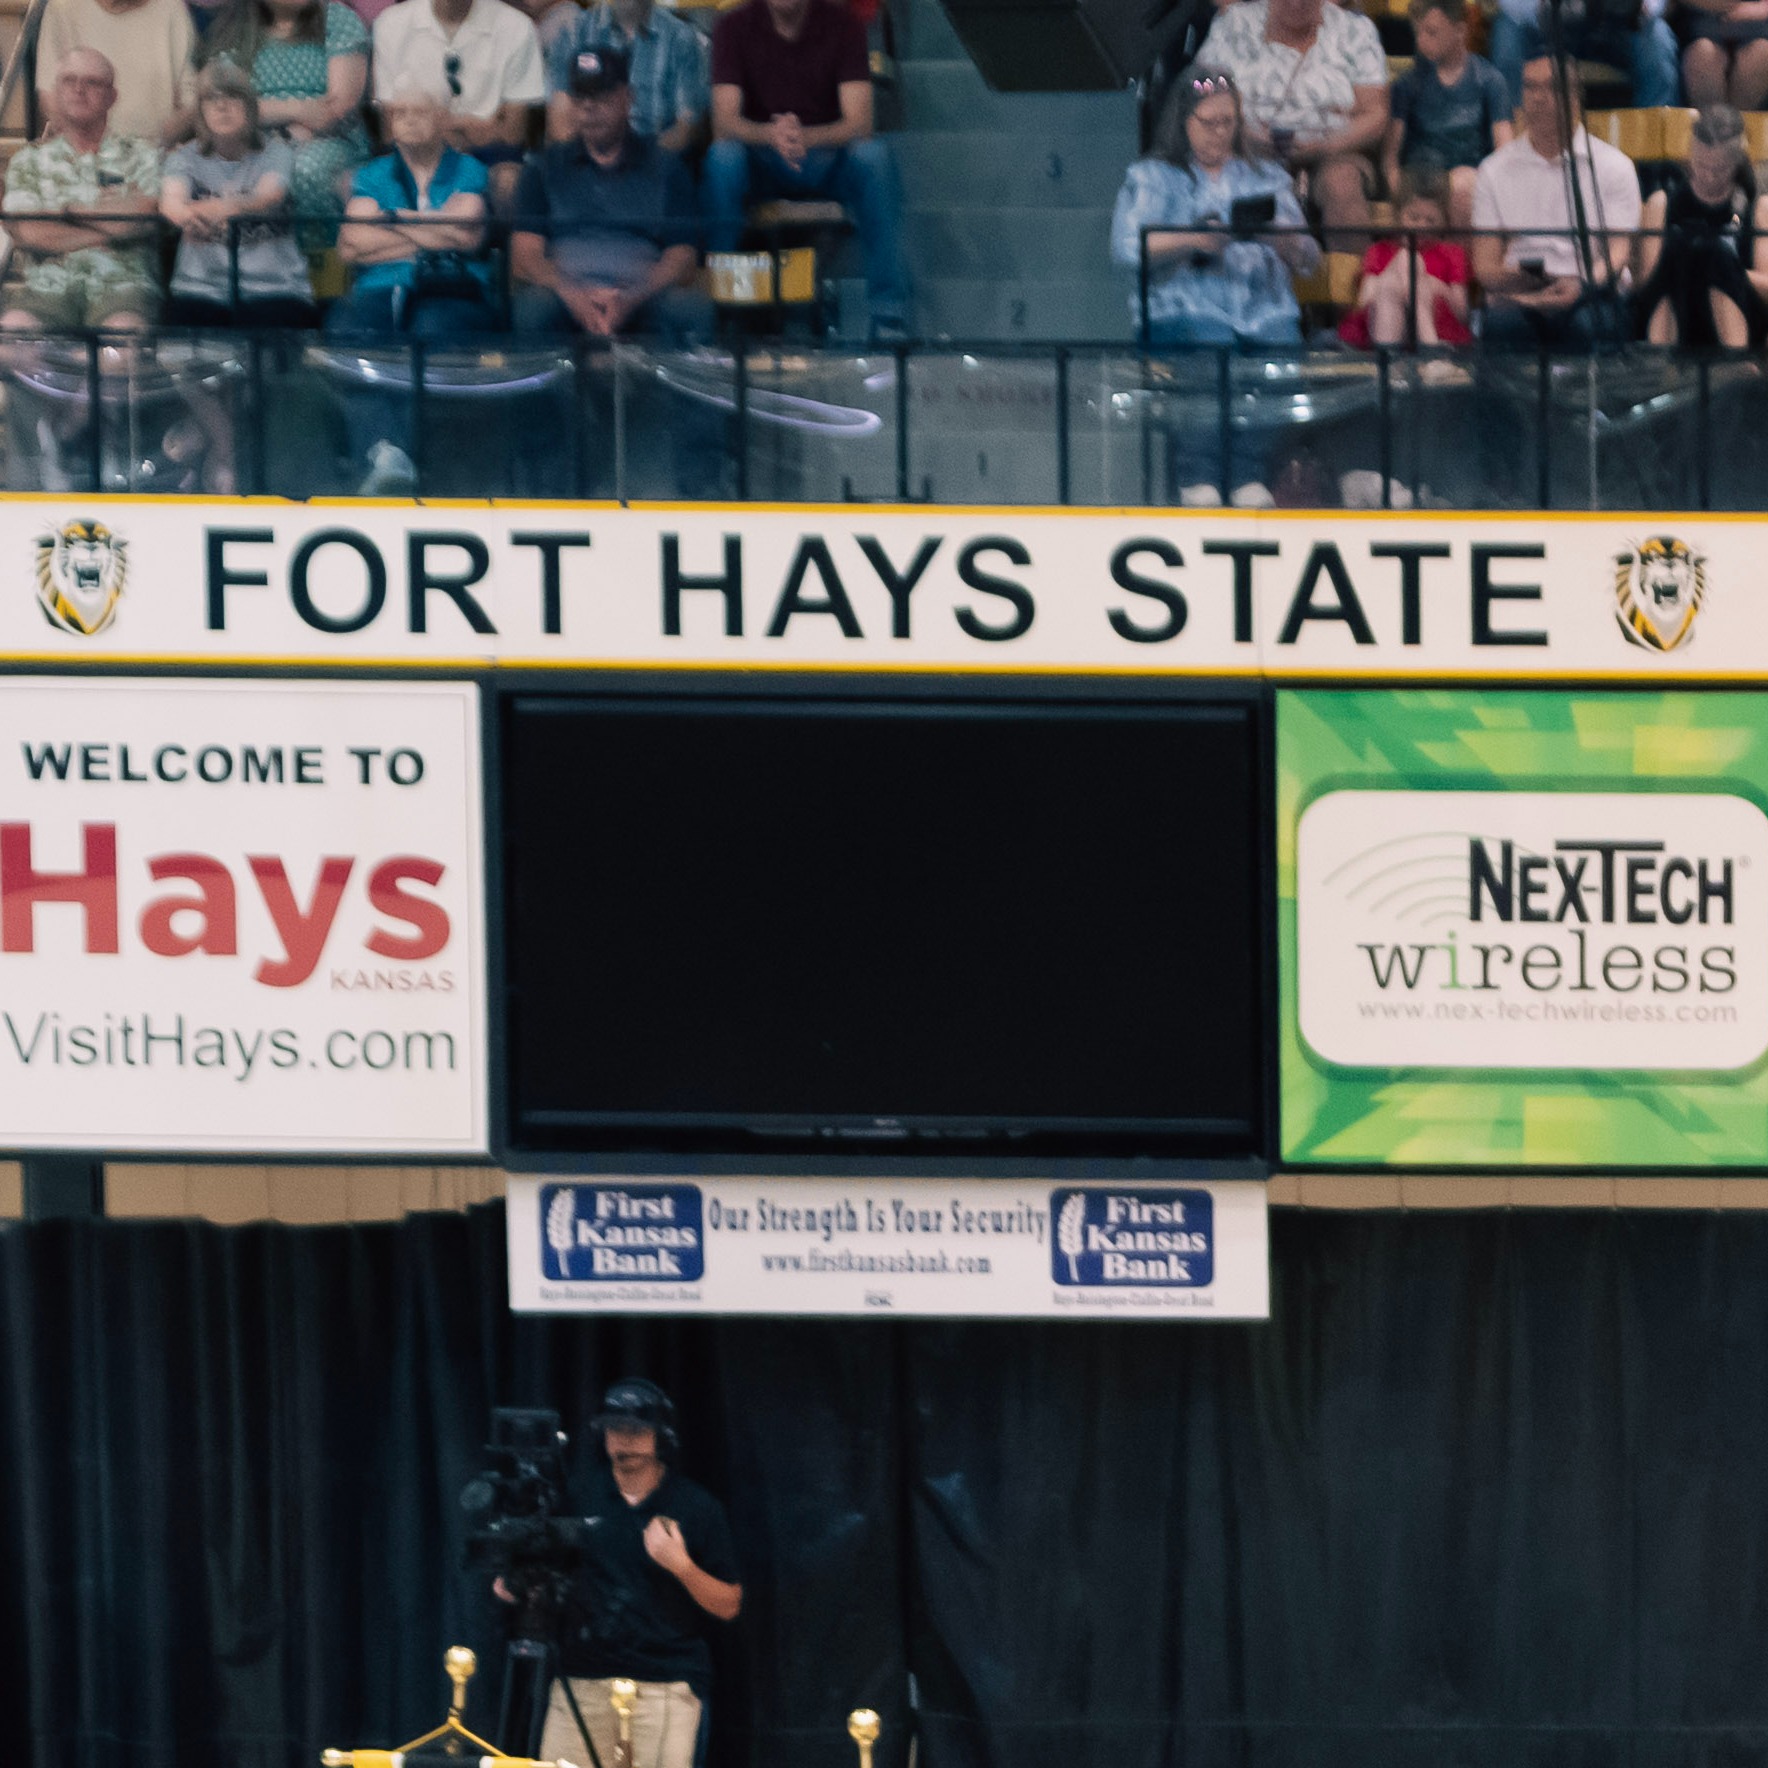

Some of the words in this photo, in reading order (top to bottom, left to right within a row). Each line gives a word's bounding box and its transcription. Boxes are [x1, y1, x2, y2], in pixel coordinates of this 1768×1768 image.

[205, 525, 591, 637] FORT
[660, 530, 1036, 643] HAYS
[1106, 536, 1549, 646] STATE
[22, 741, 324, 784] WELCOME
[348, 745, 425, 786] TO
[0, 820, 451, 988] Hays
[1357, 929, 1738, 993] wireless
[330, 968, 456, 993] KANSAS
[1357, 1000, 1738, 1023] www.nex-techwireless.com
[2, 1011, 456, 1082] VisitHays.com
[596, 1191, 675, 1220] First
[1107, 1196, 1185, 1224] First
[577, 1219, 698, 1247] Kansas
[709, 1197, 749, 1231] Our
[757, 1198, 857, 1240] Strength
[865, 1199, 886, 1232] Is
[892, 1199, 942, 1232] Your
[951, 1200, 1046, 1243] Security
[1088, 1224, 1207, 1252] Kansas
[593, 1248, 682, 1275] Bank
[1103, 1253, 1191, 1281] Bank
